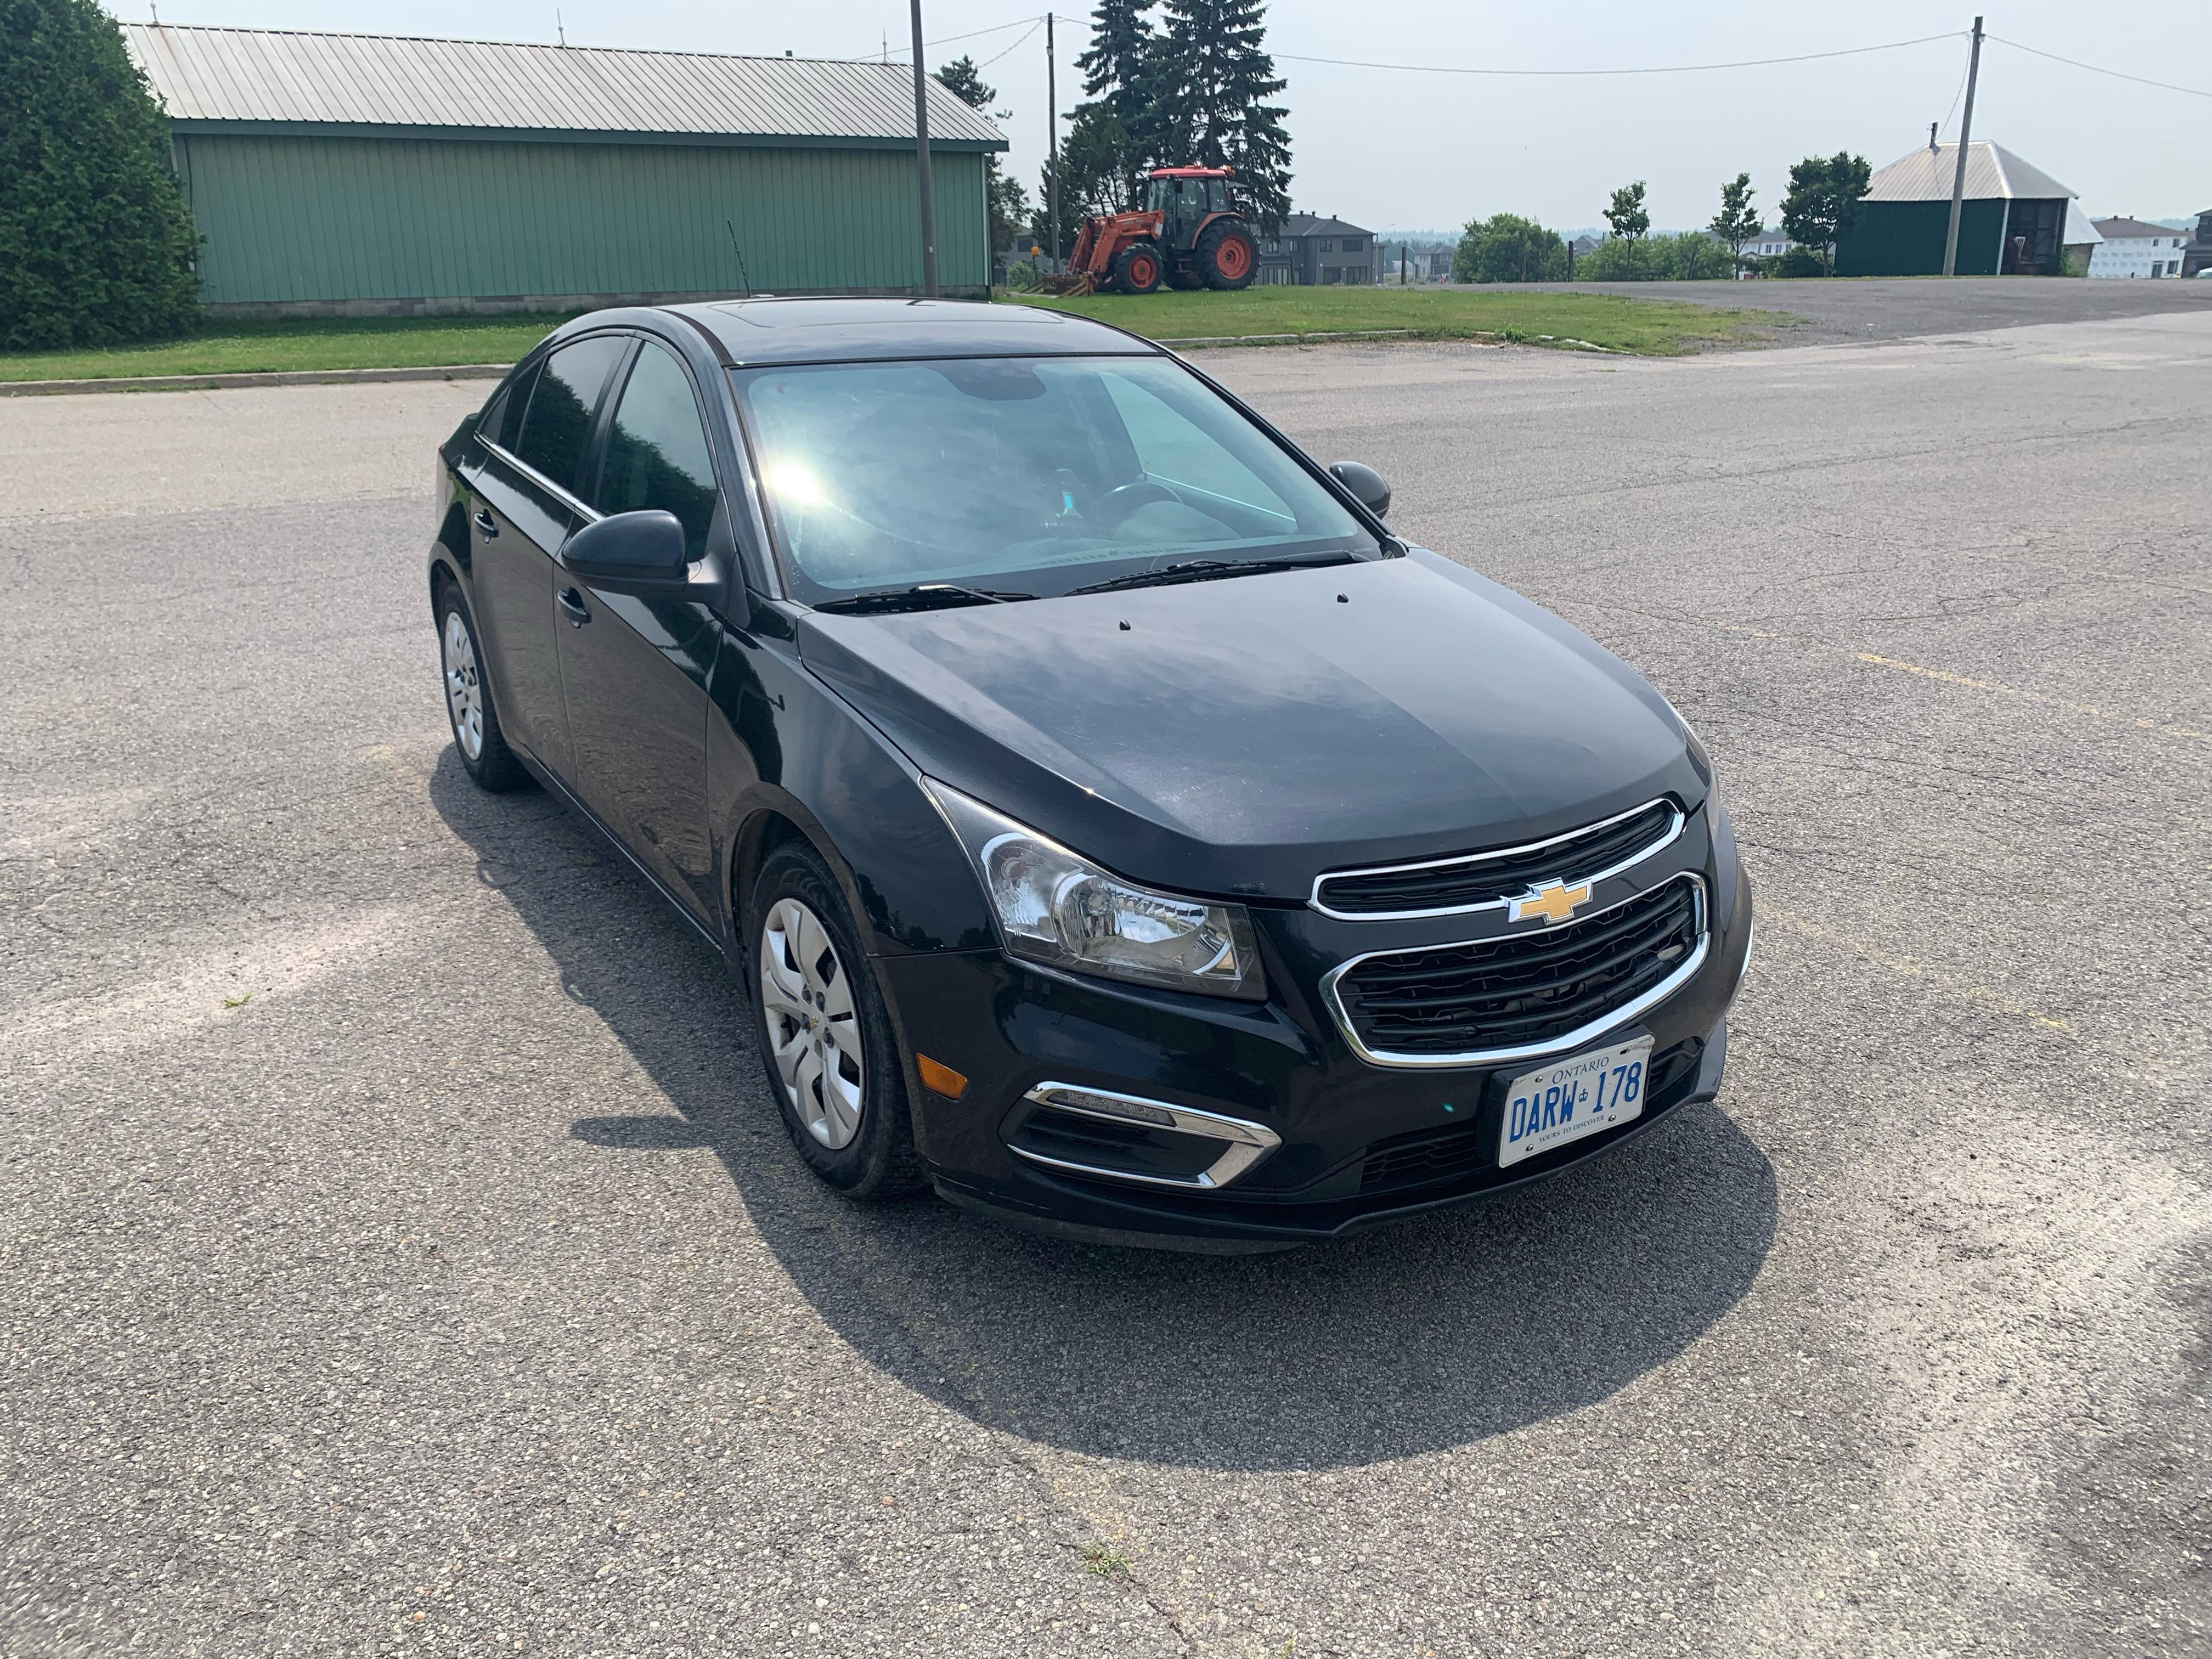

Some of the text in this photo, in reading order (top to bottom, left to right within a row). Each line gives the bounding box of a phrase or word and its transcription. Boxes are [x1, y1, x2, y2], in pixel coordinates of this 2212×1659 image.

[1552, 1057, 1609, 1084] ONTARIO
[1509, 1062, 1642, 1143] DARW 178
[1539, 1115, 1605, 1143] YOURS TO DISCOVER
